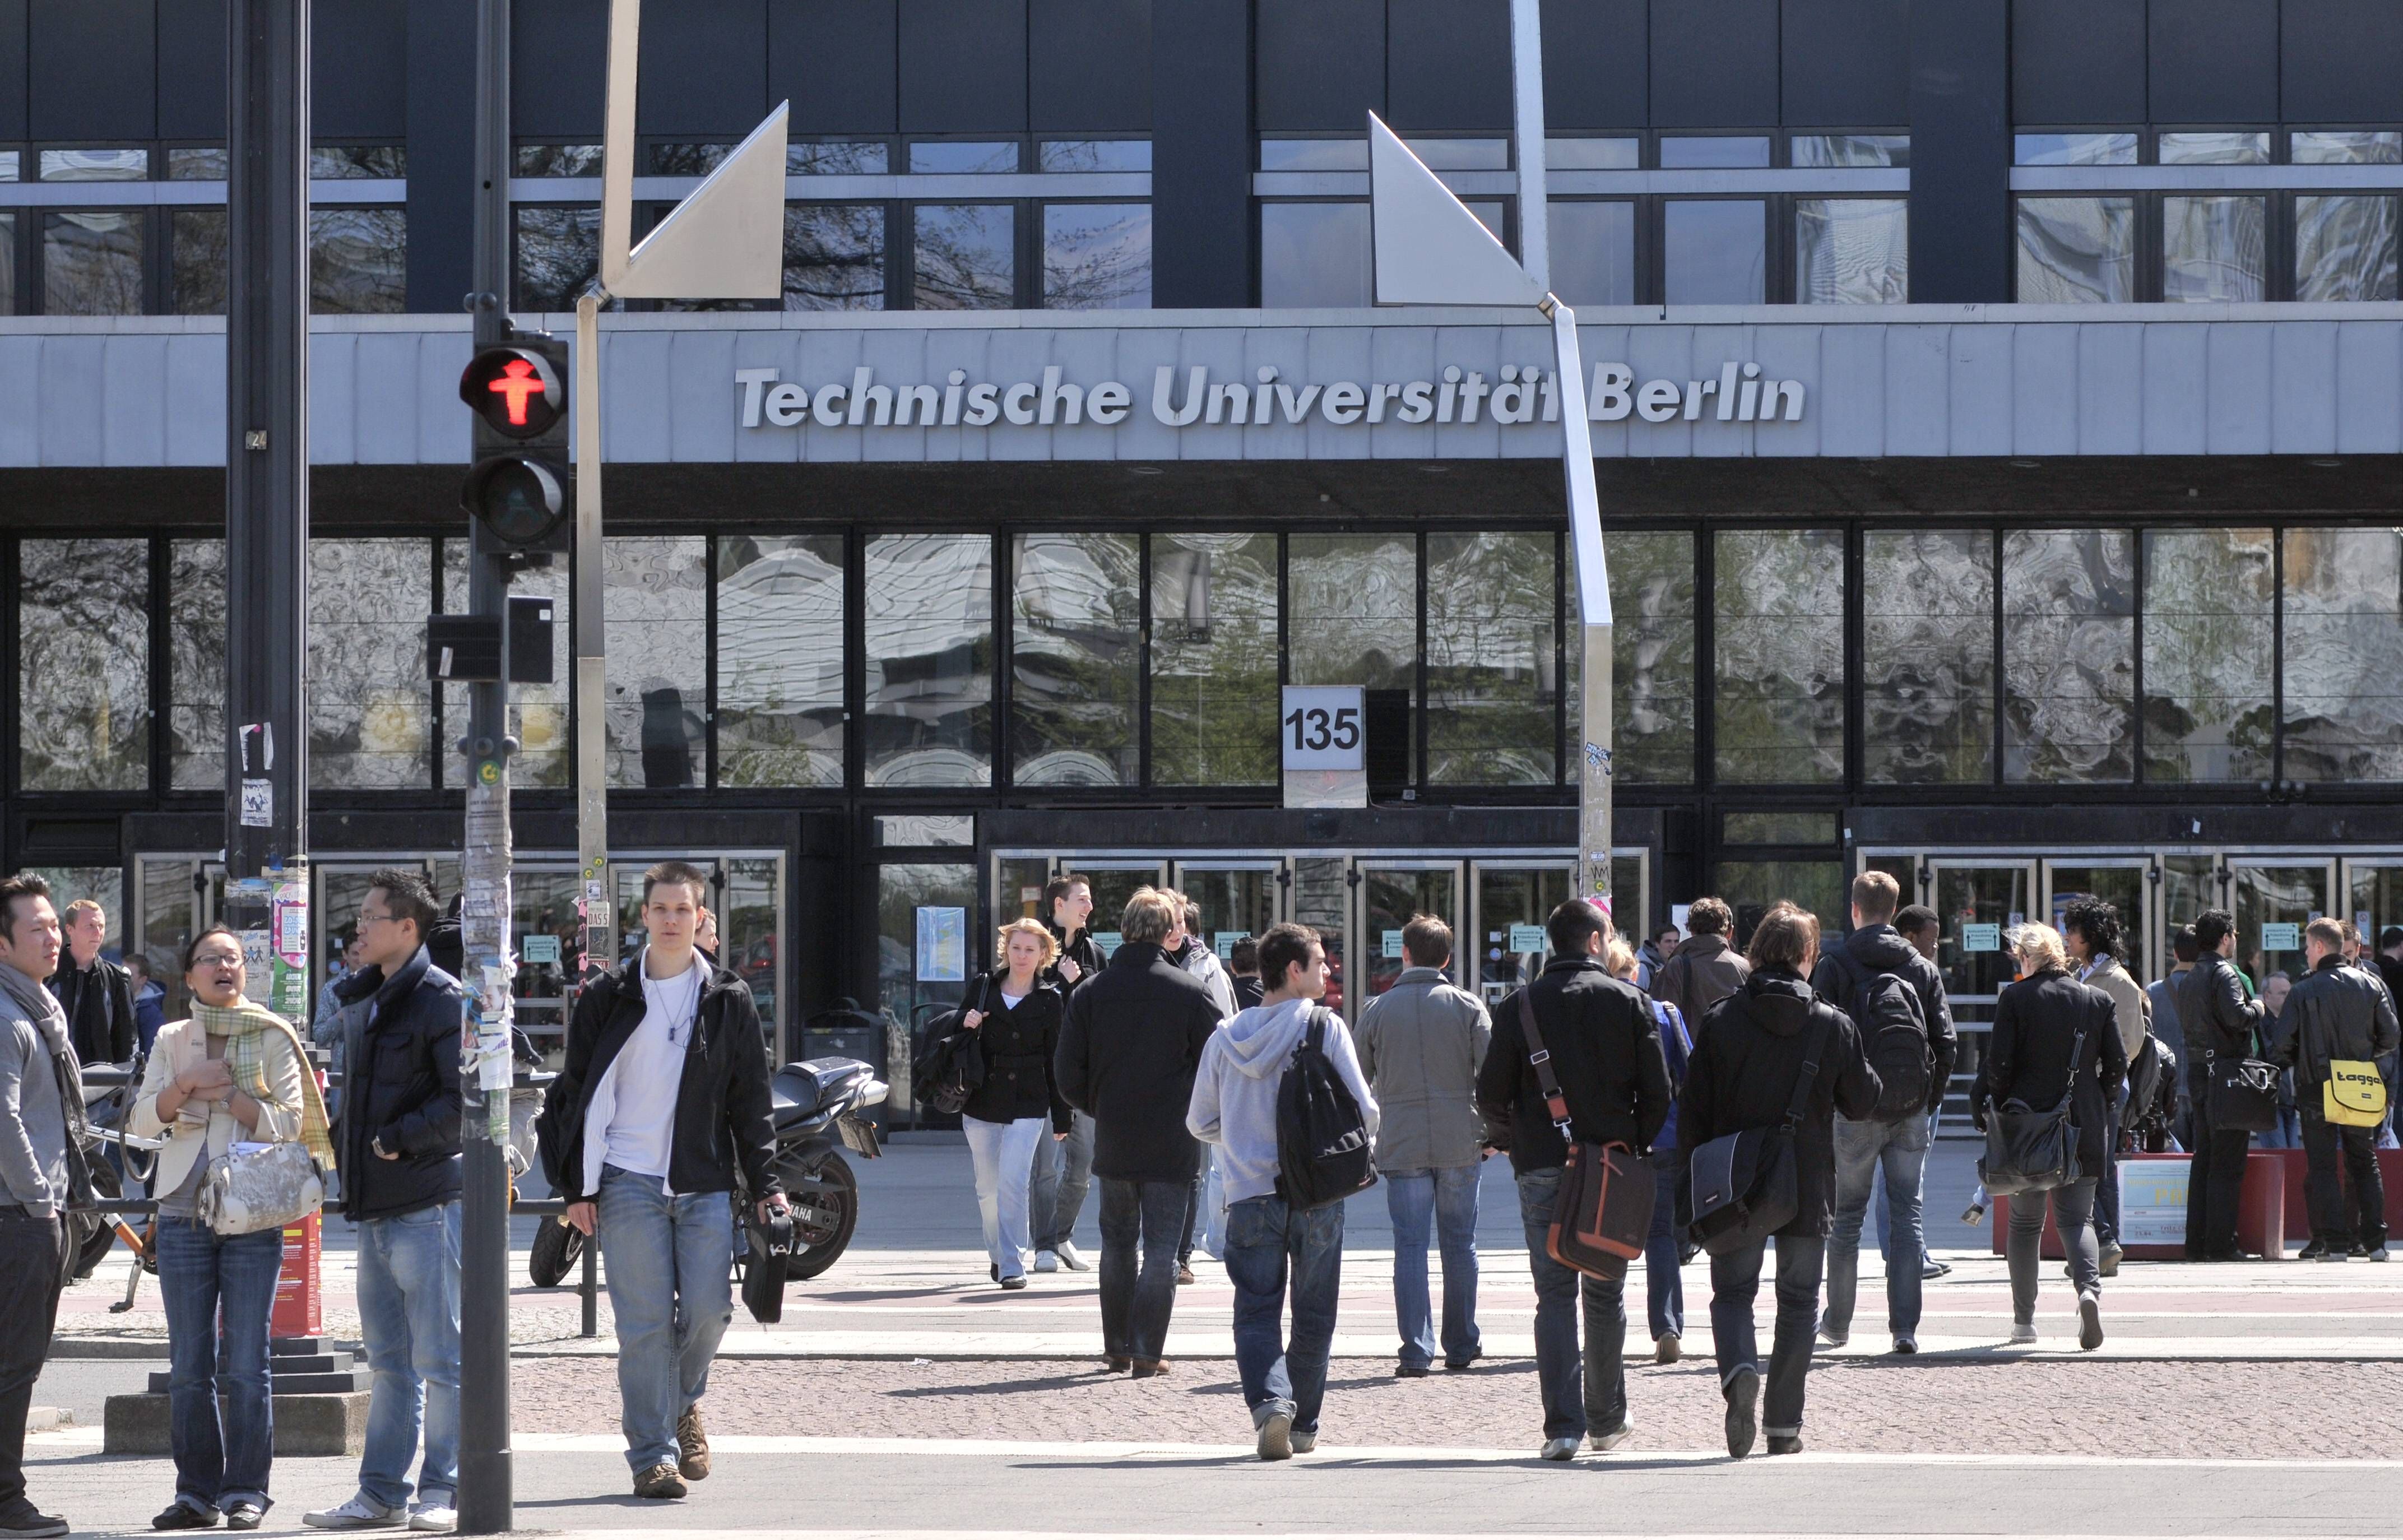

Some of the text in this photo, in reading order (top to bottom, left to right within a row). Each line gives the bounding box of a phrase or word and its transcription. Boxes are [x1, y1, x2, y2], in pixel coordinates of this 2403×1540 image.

[735, 361, 1806, 428] Technische Universität Berlin
[1286, 708, 1360, 750] 135
[588, 913, 602, 925] DAS
[2155, 1188, 2188, 1207] PA
